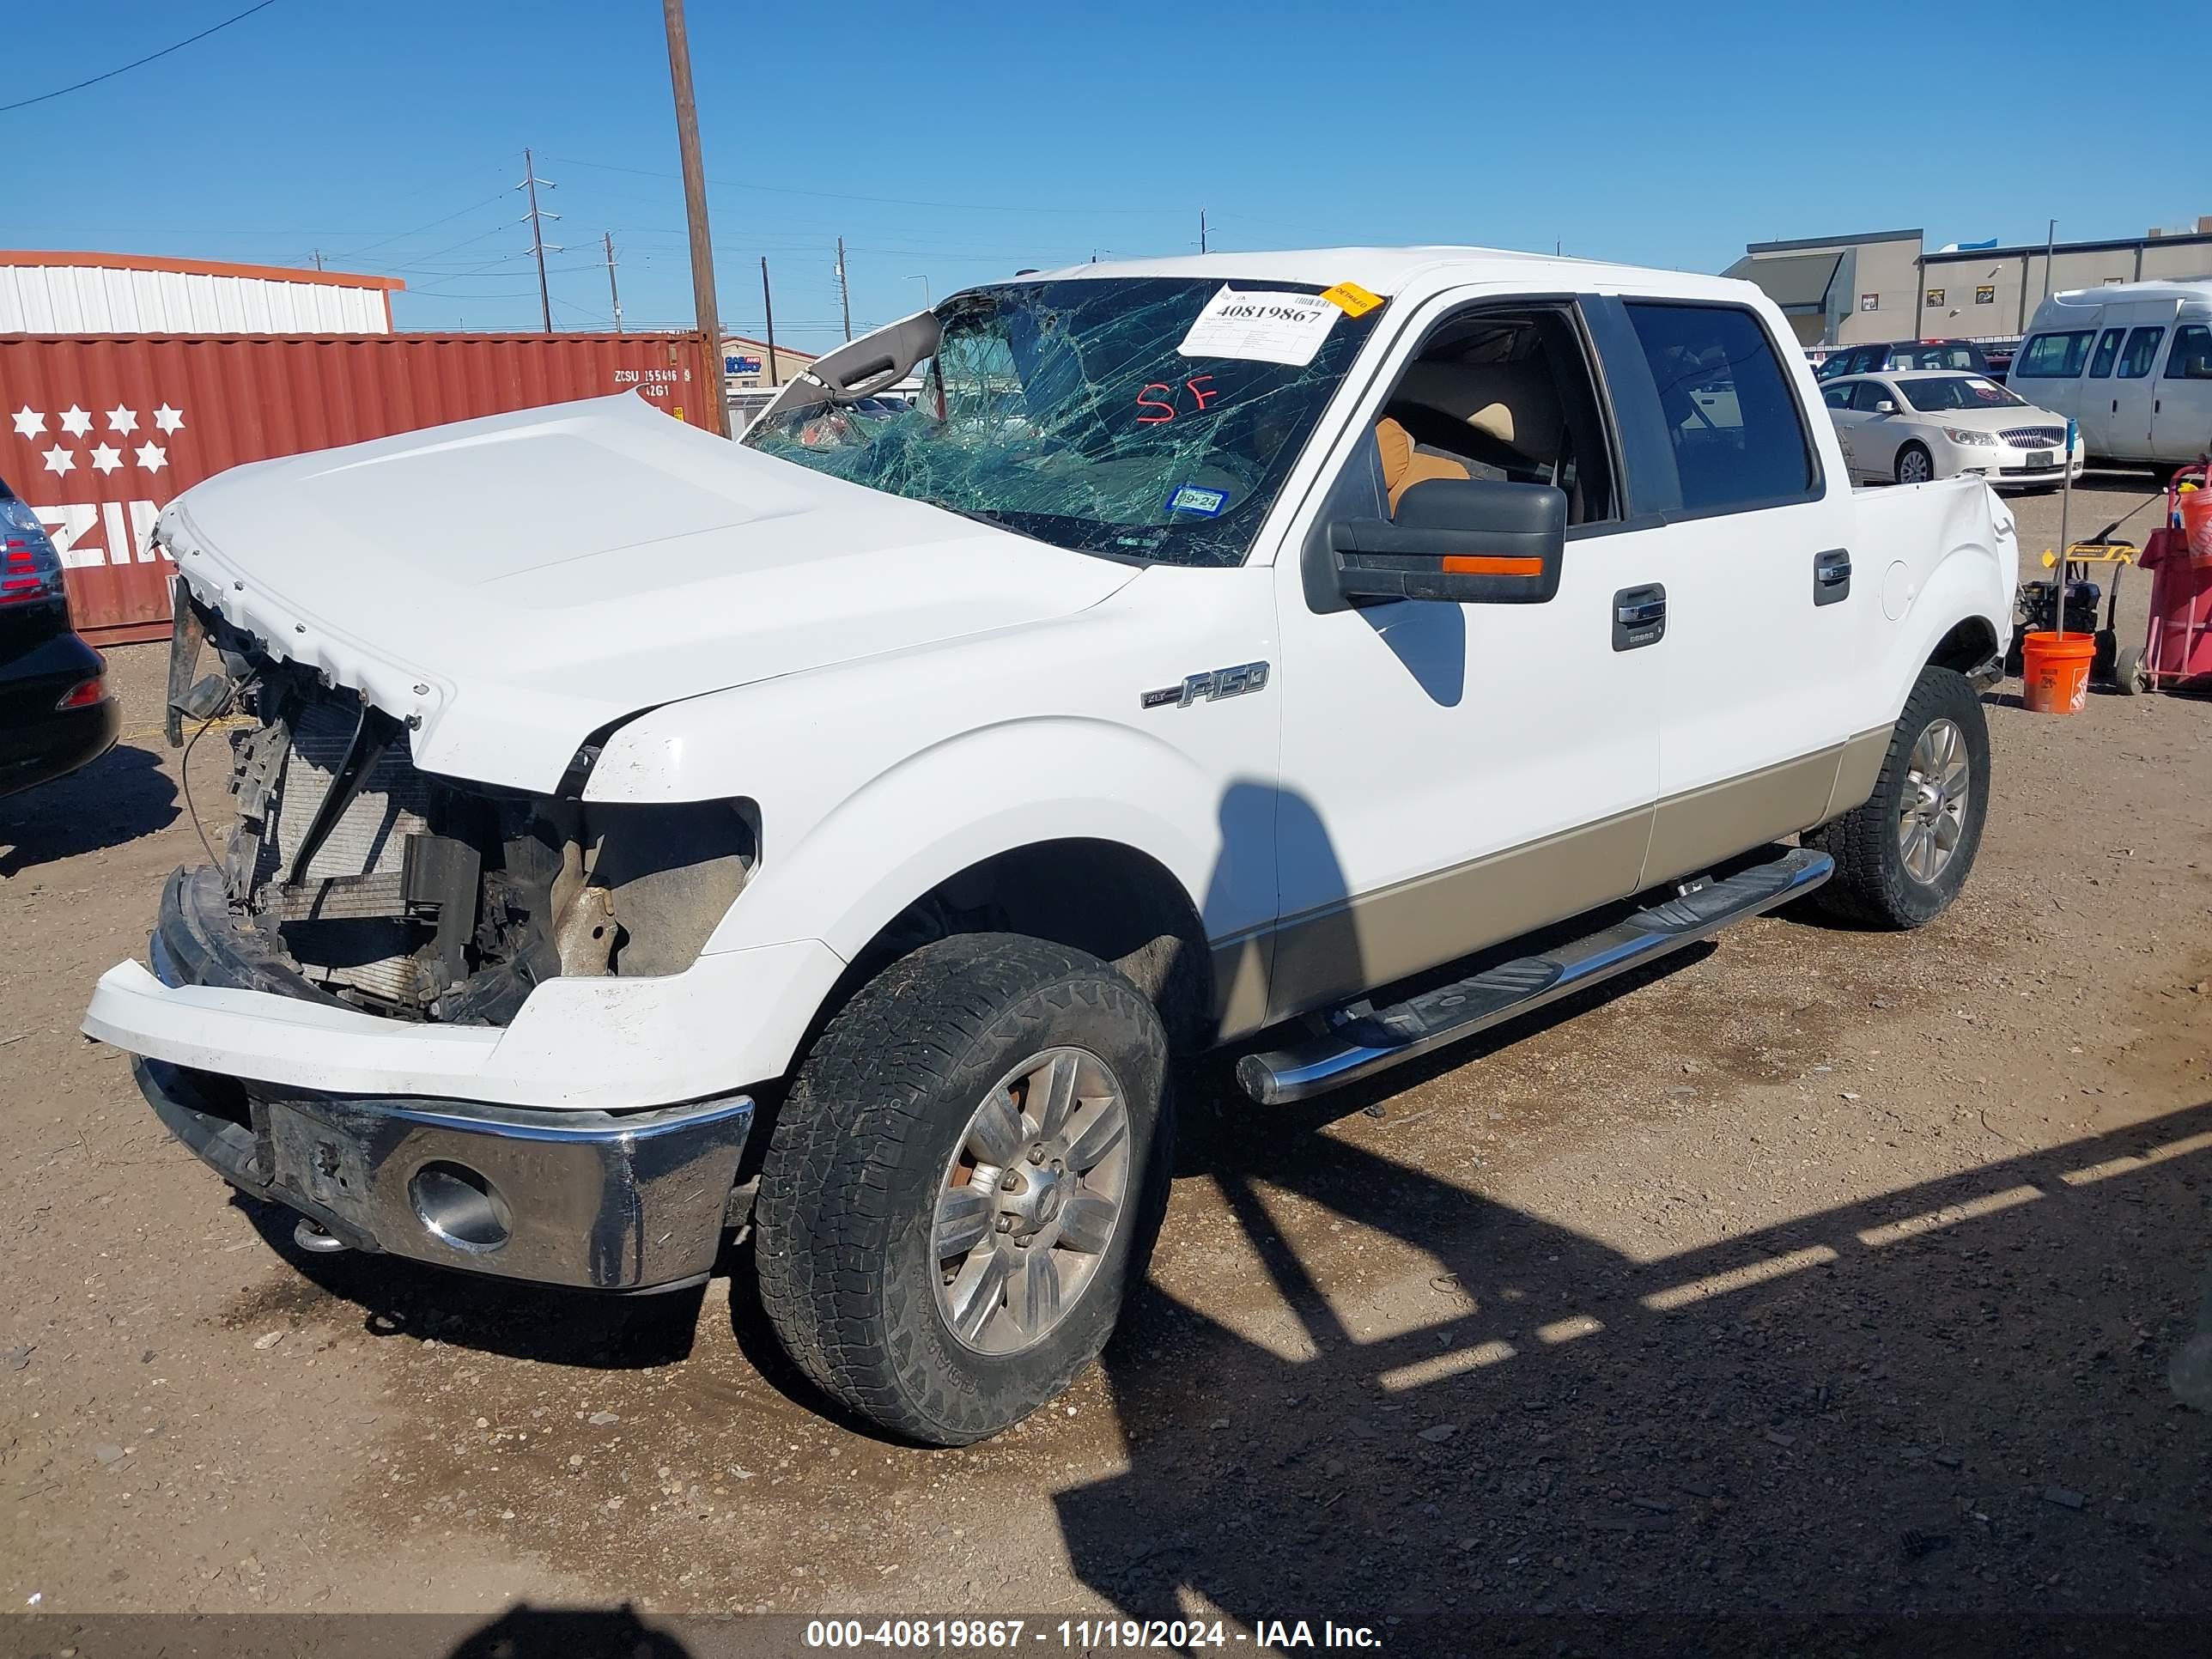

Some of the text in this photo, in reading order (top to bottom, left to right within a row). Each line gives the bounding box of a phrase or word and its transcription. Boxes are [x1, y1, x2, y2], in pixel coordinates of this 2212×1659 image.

[1335, 287, 1368, 308] DETAILED
[1216, 304, 1322, 324] 40819867
[615, 370, 639, 382] ZCSU
[1148, 693, 1165, 703] XLT
